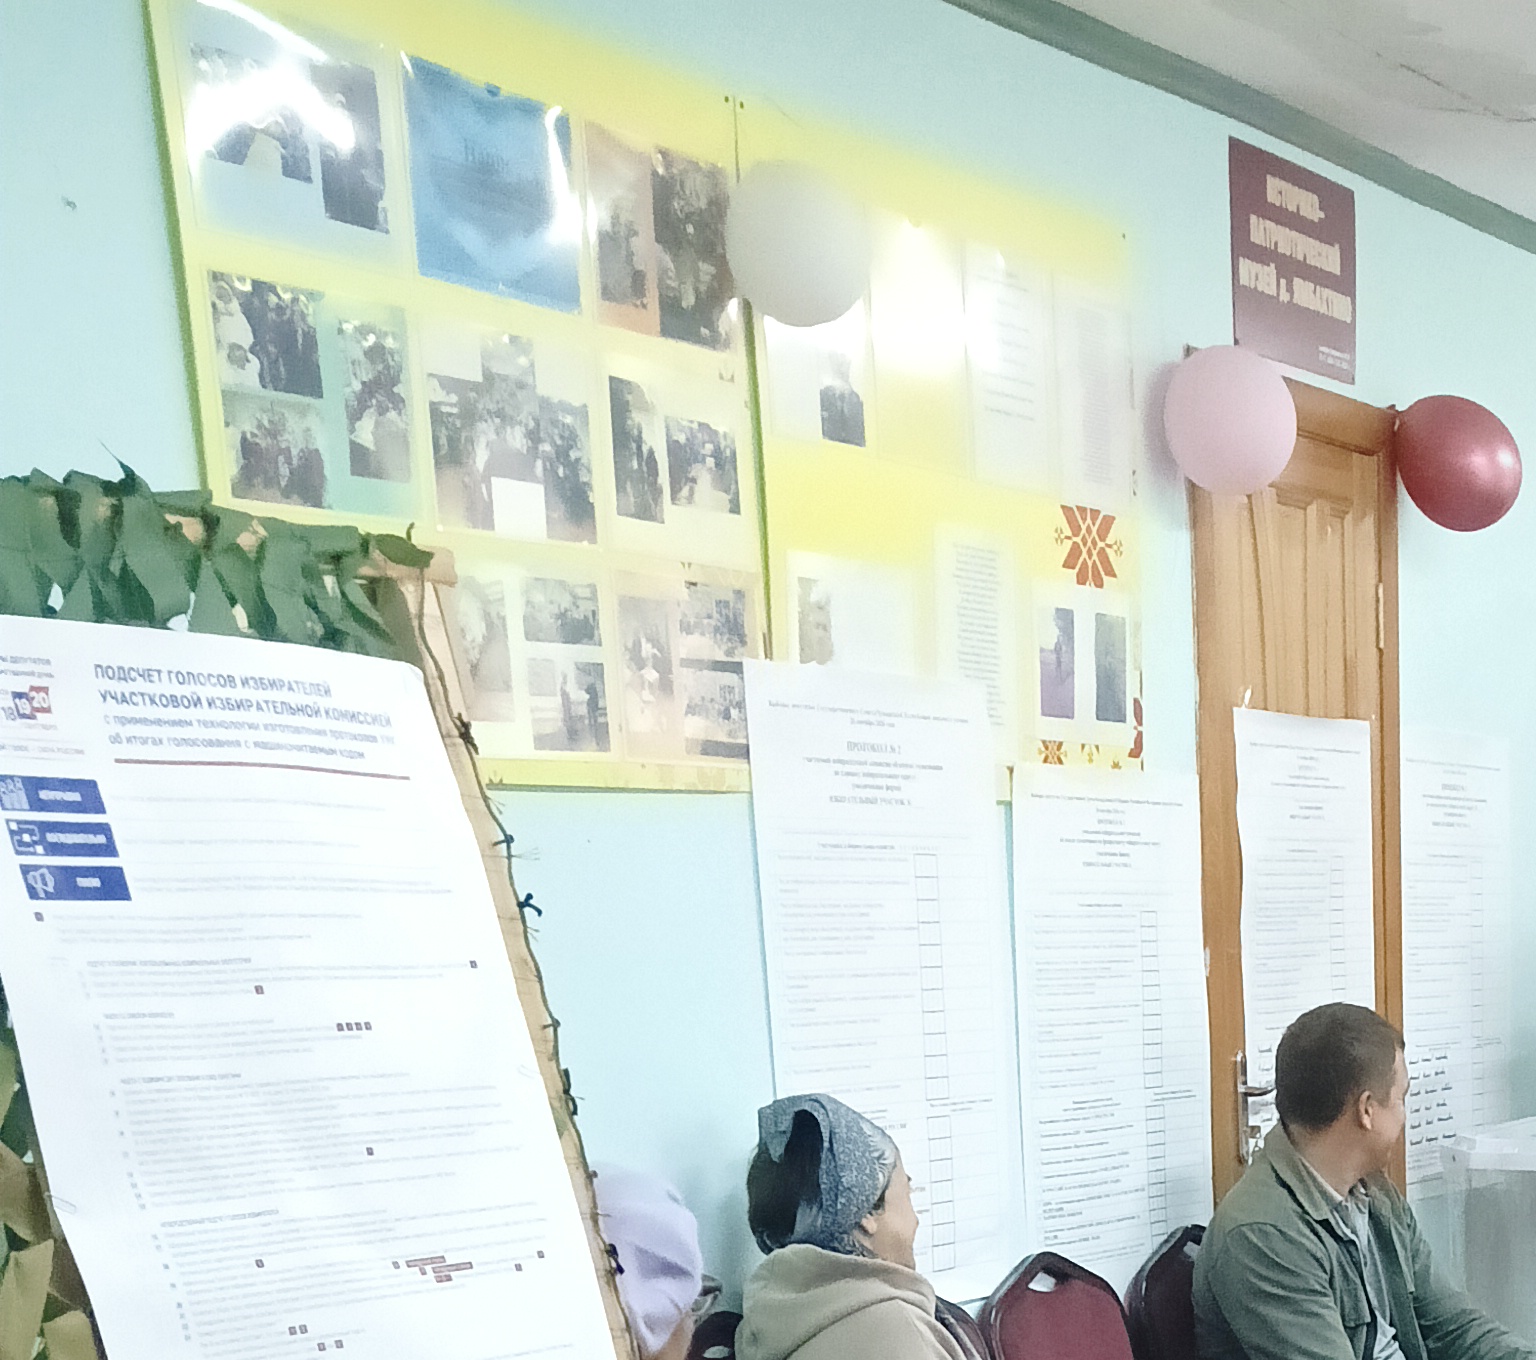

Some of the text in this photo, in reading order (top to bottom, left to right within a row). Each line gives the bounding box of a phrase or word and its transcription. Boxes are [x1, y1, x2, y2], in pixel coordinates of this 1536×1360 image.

[94, 664, 331, 698] ПОДСЧЕТ ГОЛОСОВ ИЗБИРАТЕЛЕЙ
[15, 698, 32, 714] 19
[30, 691, 49, 708] 20
[98, 689, 391, 728] УЧАСТКОВОЙ ИЗБИРАТЕЛЬНОЙ КОМИССИЕЙ
[113, 715, 194, 729] применением
[197, 718, 261, 731] технологии
[108, 732, 123, 745] об
[125, 735, 164, 746] итогах
[167, 736, 241, 749] голосования
